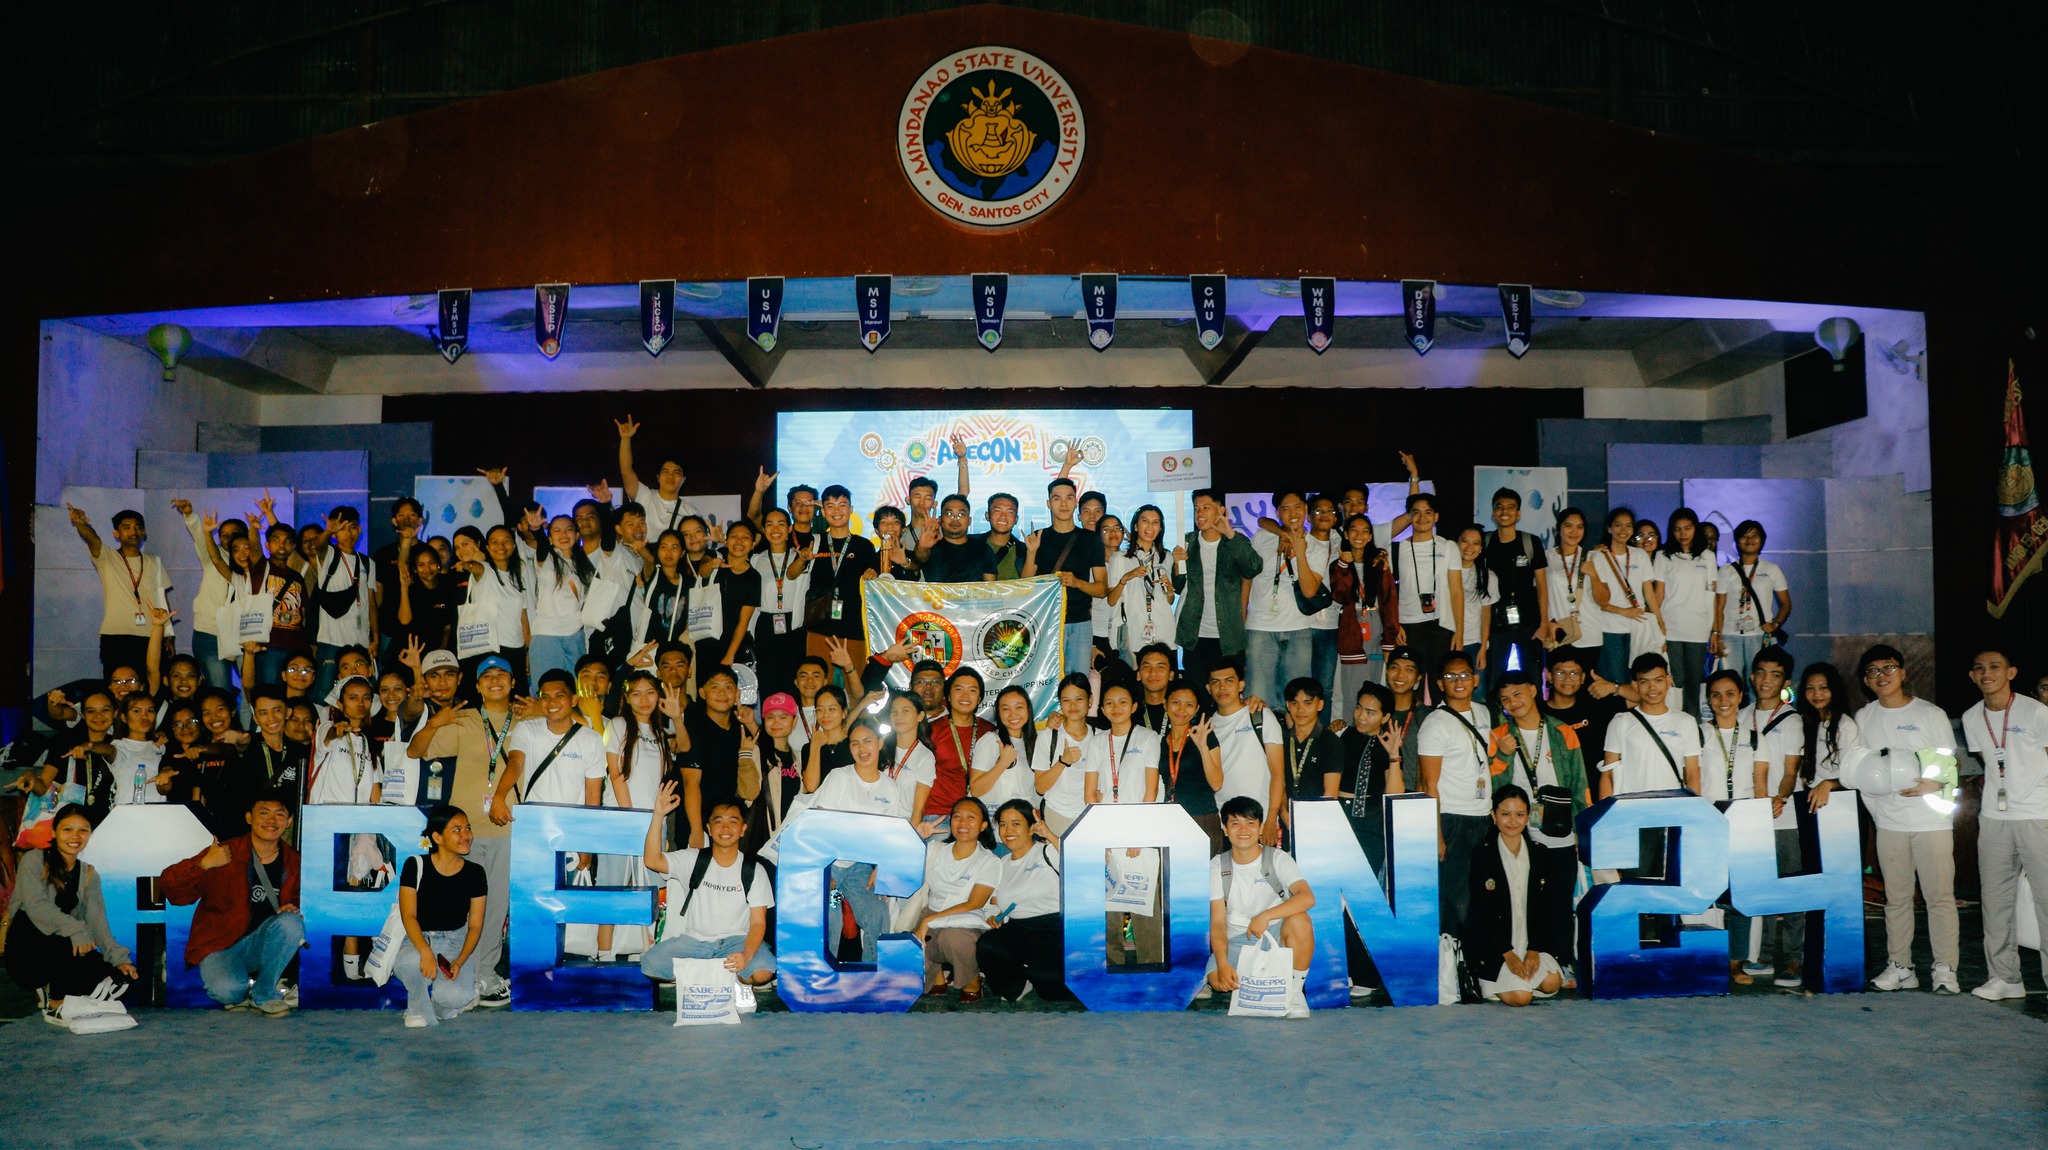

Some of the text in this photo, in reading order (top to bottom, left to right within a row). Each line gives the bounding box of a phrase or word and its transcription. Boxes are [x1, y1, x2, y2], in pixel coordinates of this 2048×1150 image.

[905, 52, 1079, 175] MINDANAO STATE UNIVERSITY
[937, 188, 1050, 219] GEN. SANTOS CITY
[450, 299, 459, 336] JRMSU
[548, 294, 557, 333] USEP
[760, 289, 772, 324] USM
[867, 286, 880, 320] MSU
[984, 285, 996, 318] MSU
[1094, 285, 1105, 318] MSU
[1203, 286, 1215, 322] CMU
[1311, 287, 1324, 326] WMSU
[1414, 291, 1424, 329] DSSC
[1511, 293, 1520, 331] USTP
[937, 437, 1021, 466] AECON
[1022, 440, 1037, 451] 20
[1022, 452, 1039, 462] 24
[909, 613, 955, 635] SOUTHEASTERN
[980, 653, 1034, 677] USEP CHAPTER
[1022, 678, 1054, 689] IPPINES
[703, 880, 742, 892] INHINYERO
[1575, 790, 1863, 998] 24
